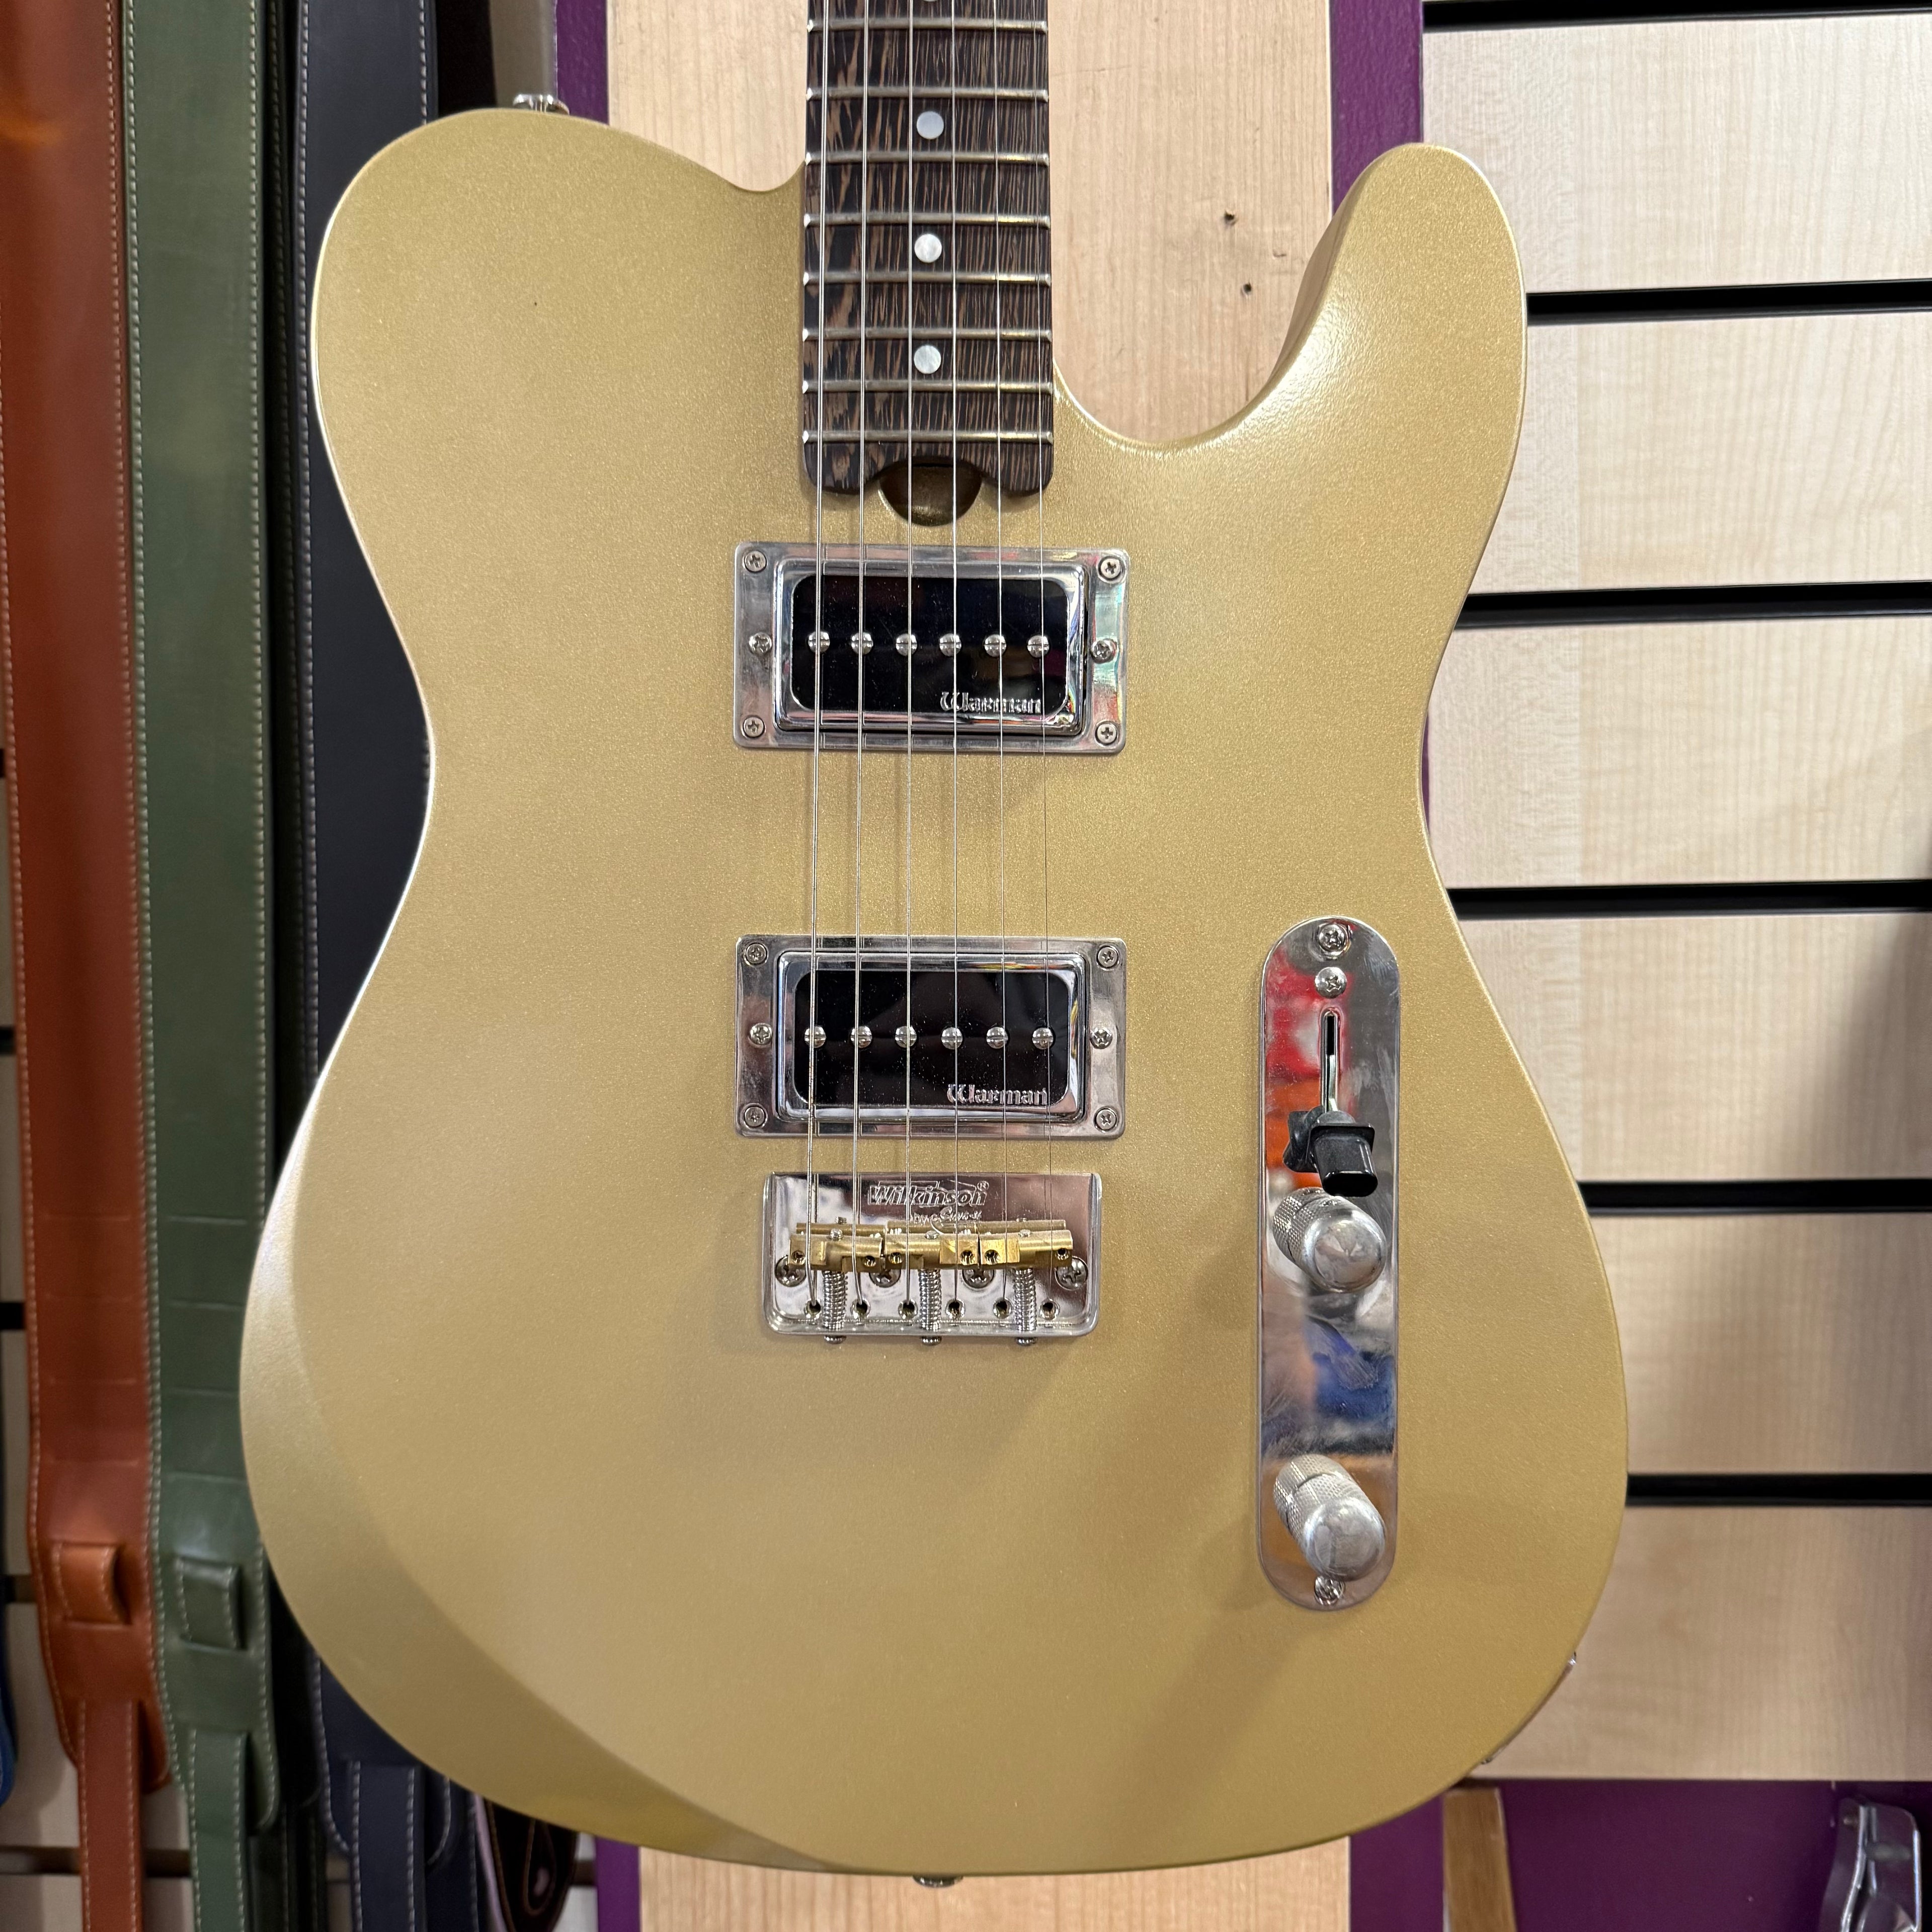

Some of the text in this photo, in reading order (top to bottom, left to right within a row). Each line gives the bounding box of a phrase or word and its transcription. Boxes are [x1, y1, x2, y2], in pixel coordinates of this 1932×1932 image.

[940, 691, 1041, 713] Warman
[947, 1084, 1048, 1105] Warman
[912, 1212, 929, 1226] by
